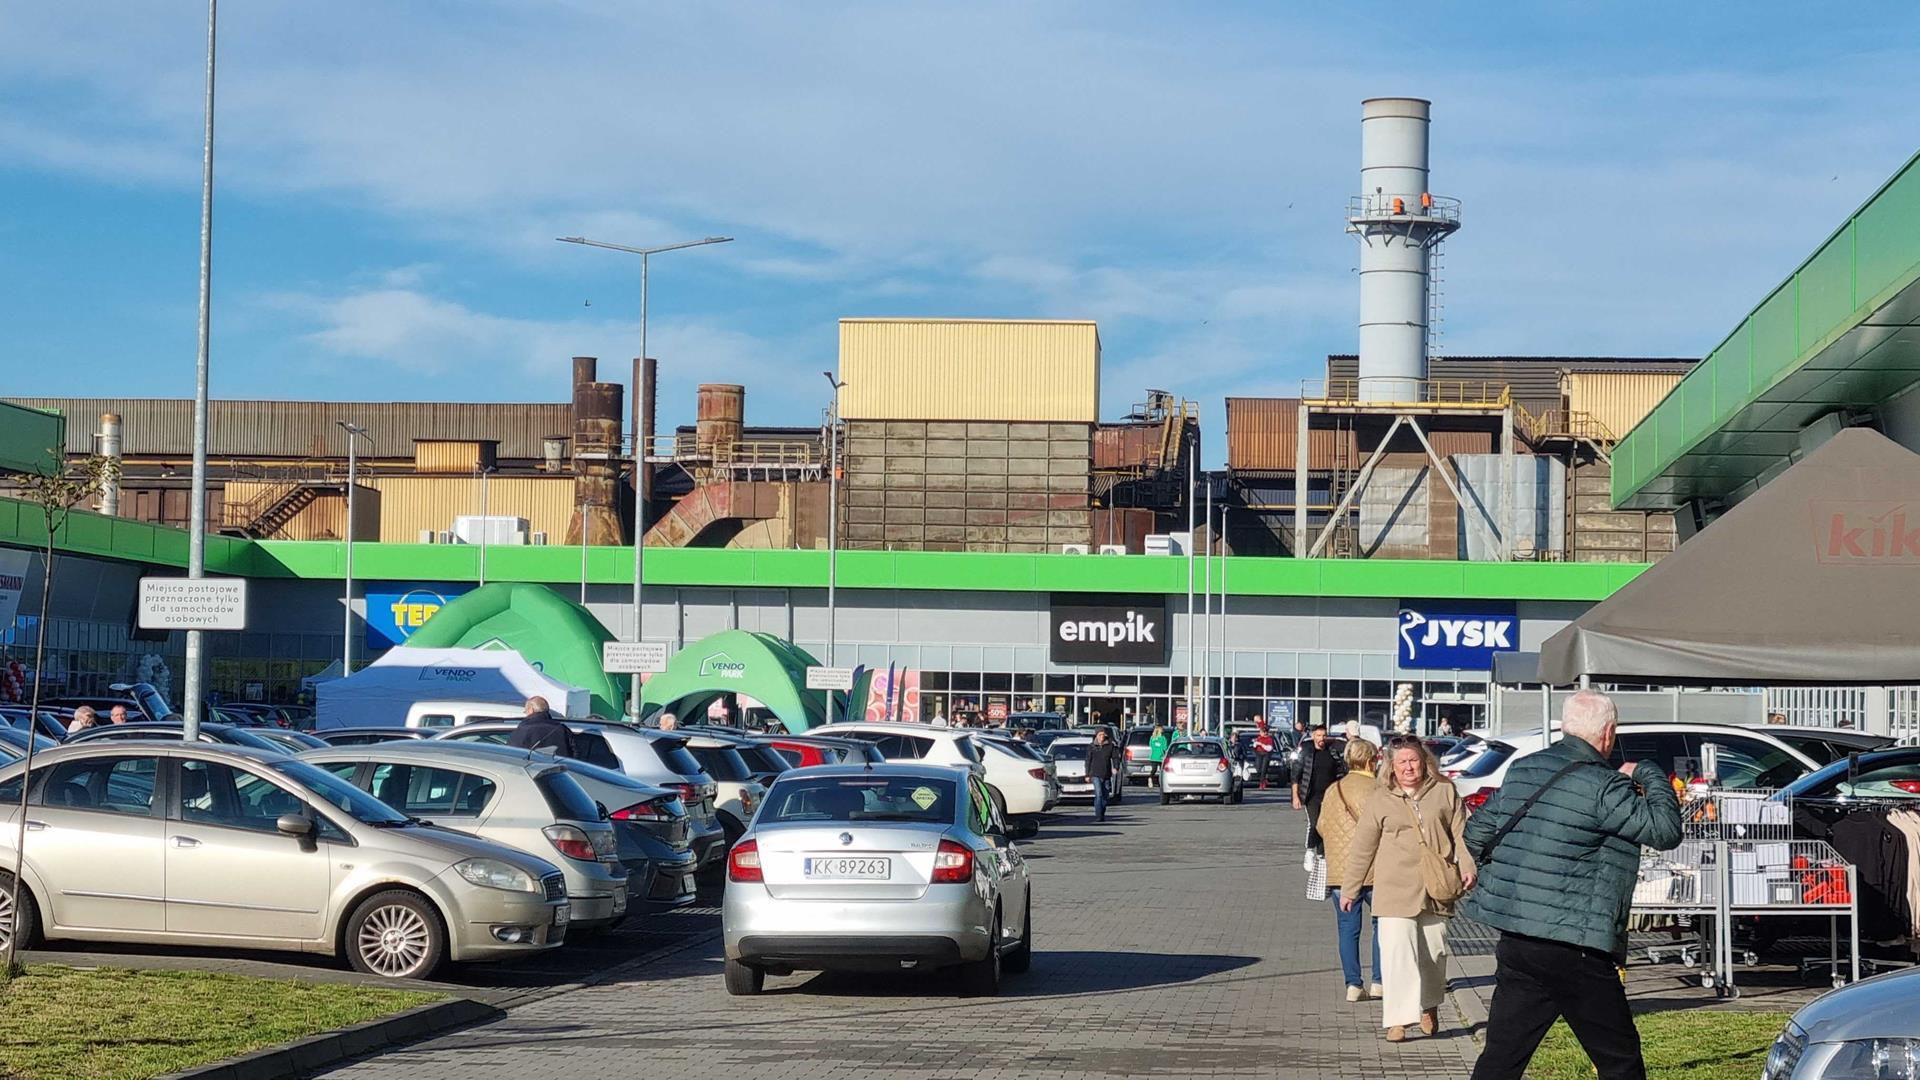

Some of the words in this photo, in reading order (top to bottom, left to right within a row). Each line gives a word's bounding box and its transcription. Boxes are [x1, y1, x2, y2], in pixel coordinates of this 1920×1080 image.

[146, 584, 184, 594] Miejsca
[188, 585, 239, 594] postojowe
[145, 595, 212, 603] przeznaczone
[216, 595, 239, 605] tylko
[150, 604, 166, 612] dla
[165, 615, 219, 624] osobowych
[1059, 611, 1155, 647] empik
[1421, 620, 1511, 647] JYSK
[712, 662, 745, 671] VENDO
[434, 669, 476, 678] VENDO
[814, 860, 833, 875] KK
[839, 860, 885, 875] 89263
